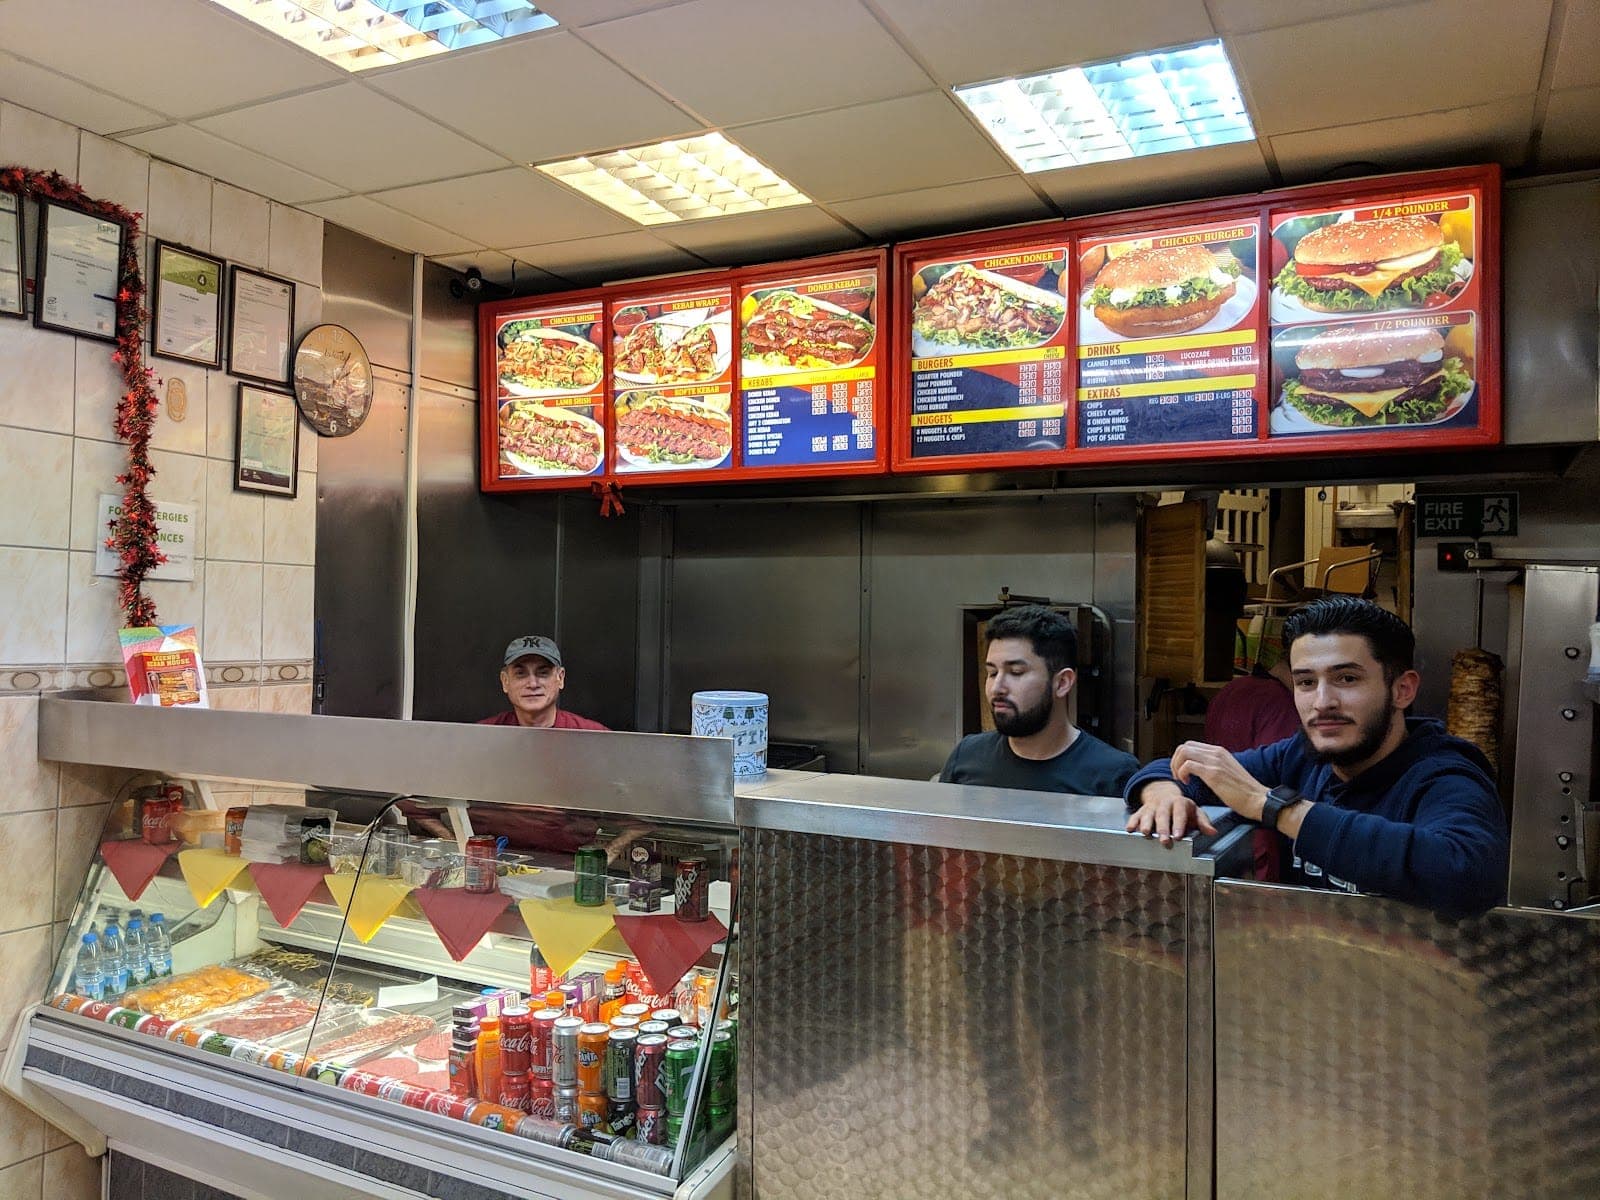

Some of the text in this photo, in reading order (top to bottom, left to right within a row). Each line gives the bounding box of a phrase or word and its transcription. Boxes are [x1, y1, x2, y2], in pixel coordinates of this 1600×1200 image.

[1372, 201, 1449, 219] 1/4 POUNDER
[1160, 228, 1245, 247] CHICKEN BURGER
[984, 252, 1054, 268] CHICKEN DONER
[808, 279, 861, 292] DONER KEBAB
[672, 298, 720, 311] KEBAB WRAPS
[549, 314, 595, 325] CHICKEN SHISH
[1374, 315, 1449, 331] 1/2 POUNDER
[1087, 344, 1121, 357] DRINKS
[1180, 350, 1211, 360] LUCOZADE
[917, 358, 953, 370] BURGERS
[1087, 358, 1131, 368] CANNED DRINKS
[940, 371, 963, 379] POUNDER
[930, 379, 953, 387] POUNDER
[301, 391, 307, 400] 8
[697, 386, 720, 395] KEBAB
[917, 386, 957, 396] CHICKEN BURGER
[1087, 387, 1121, 399] EXTRAS
[555, 397, 592, 406] LAMB SHISH
[917, 394, 964, 404] CHICKEN SANDWICH
[1087, 401, 1103, 409] CHIPS
[1087, 408, 1124, 418] CHEESY CHIPS
[347, 418, 352, 428] 5
[917, 414, 953, 425] NUGGETS
[1111, 416, 1129, 424] RINGS
[330, 420, 337, 433] 6
[920, 427, 943, 435] NUGGETS
[1087, 426, 1103, 434] CHIPS
[1111, 424, 1127, 432] PITTA
[951, 433, 966, 441] CHIPS
[1099, 434, 1106, 442] OF
[1107, 433, 1125, 441] SAUCE
[1425, 502, 1464, 515] FIRE
[156, 511, 189, 523] ERGIES
[1425, 517, 1464, 530] EXIT
